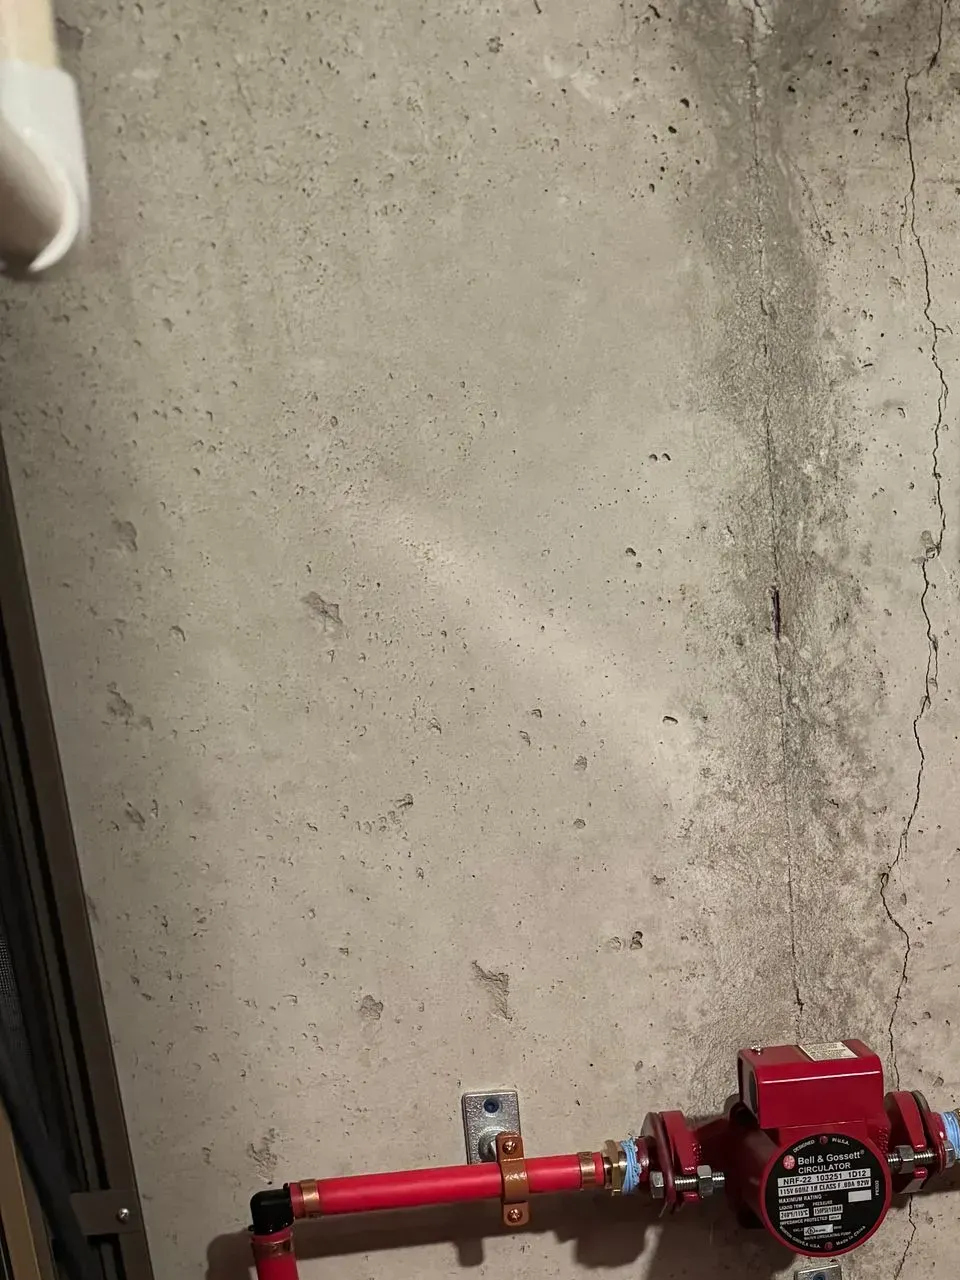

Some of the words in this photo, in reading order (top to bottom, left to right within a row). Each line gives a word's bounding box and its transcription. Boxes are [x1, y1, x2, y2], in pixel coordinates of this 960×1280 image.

[798, 1156, 814, 1165] Bell
[798, 1162, 851, 1174] CIRCULATOR
[783, 1176, 812, 1185] NRF-22
[816, 1173, 842, 1181] 103251
